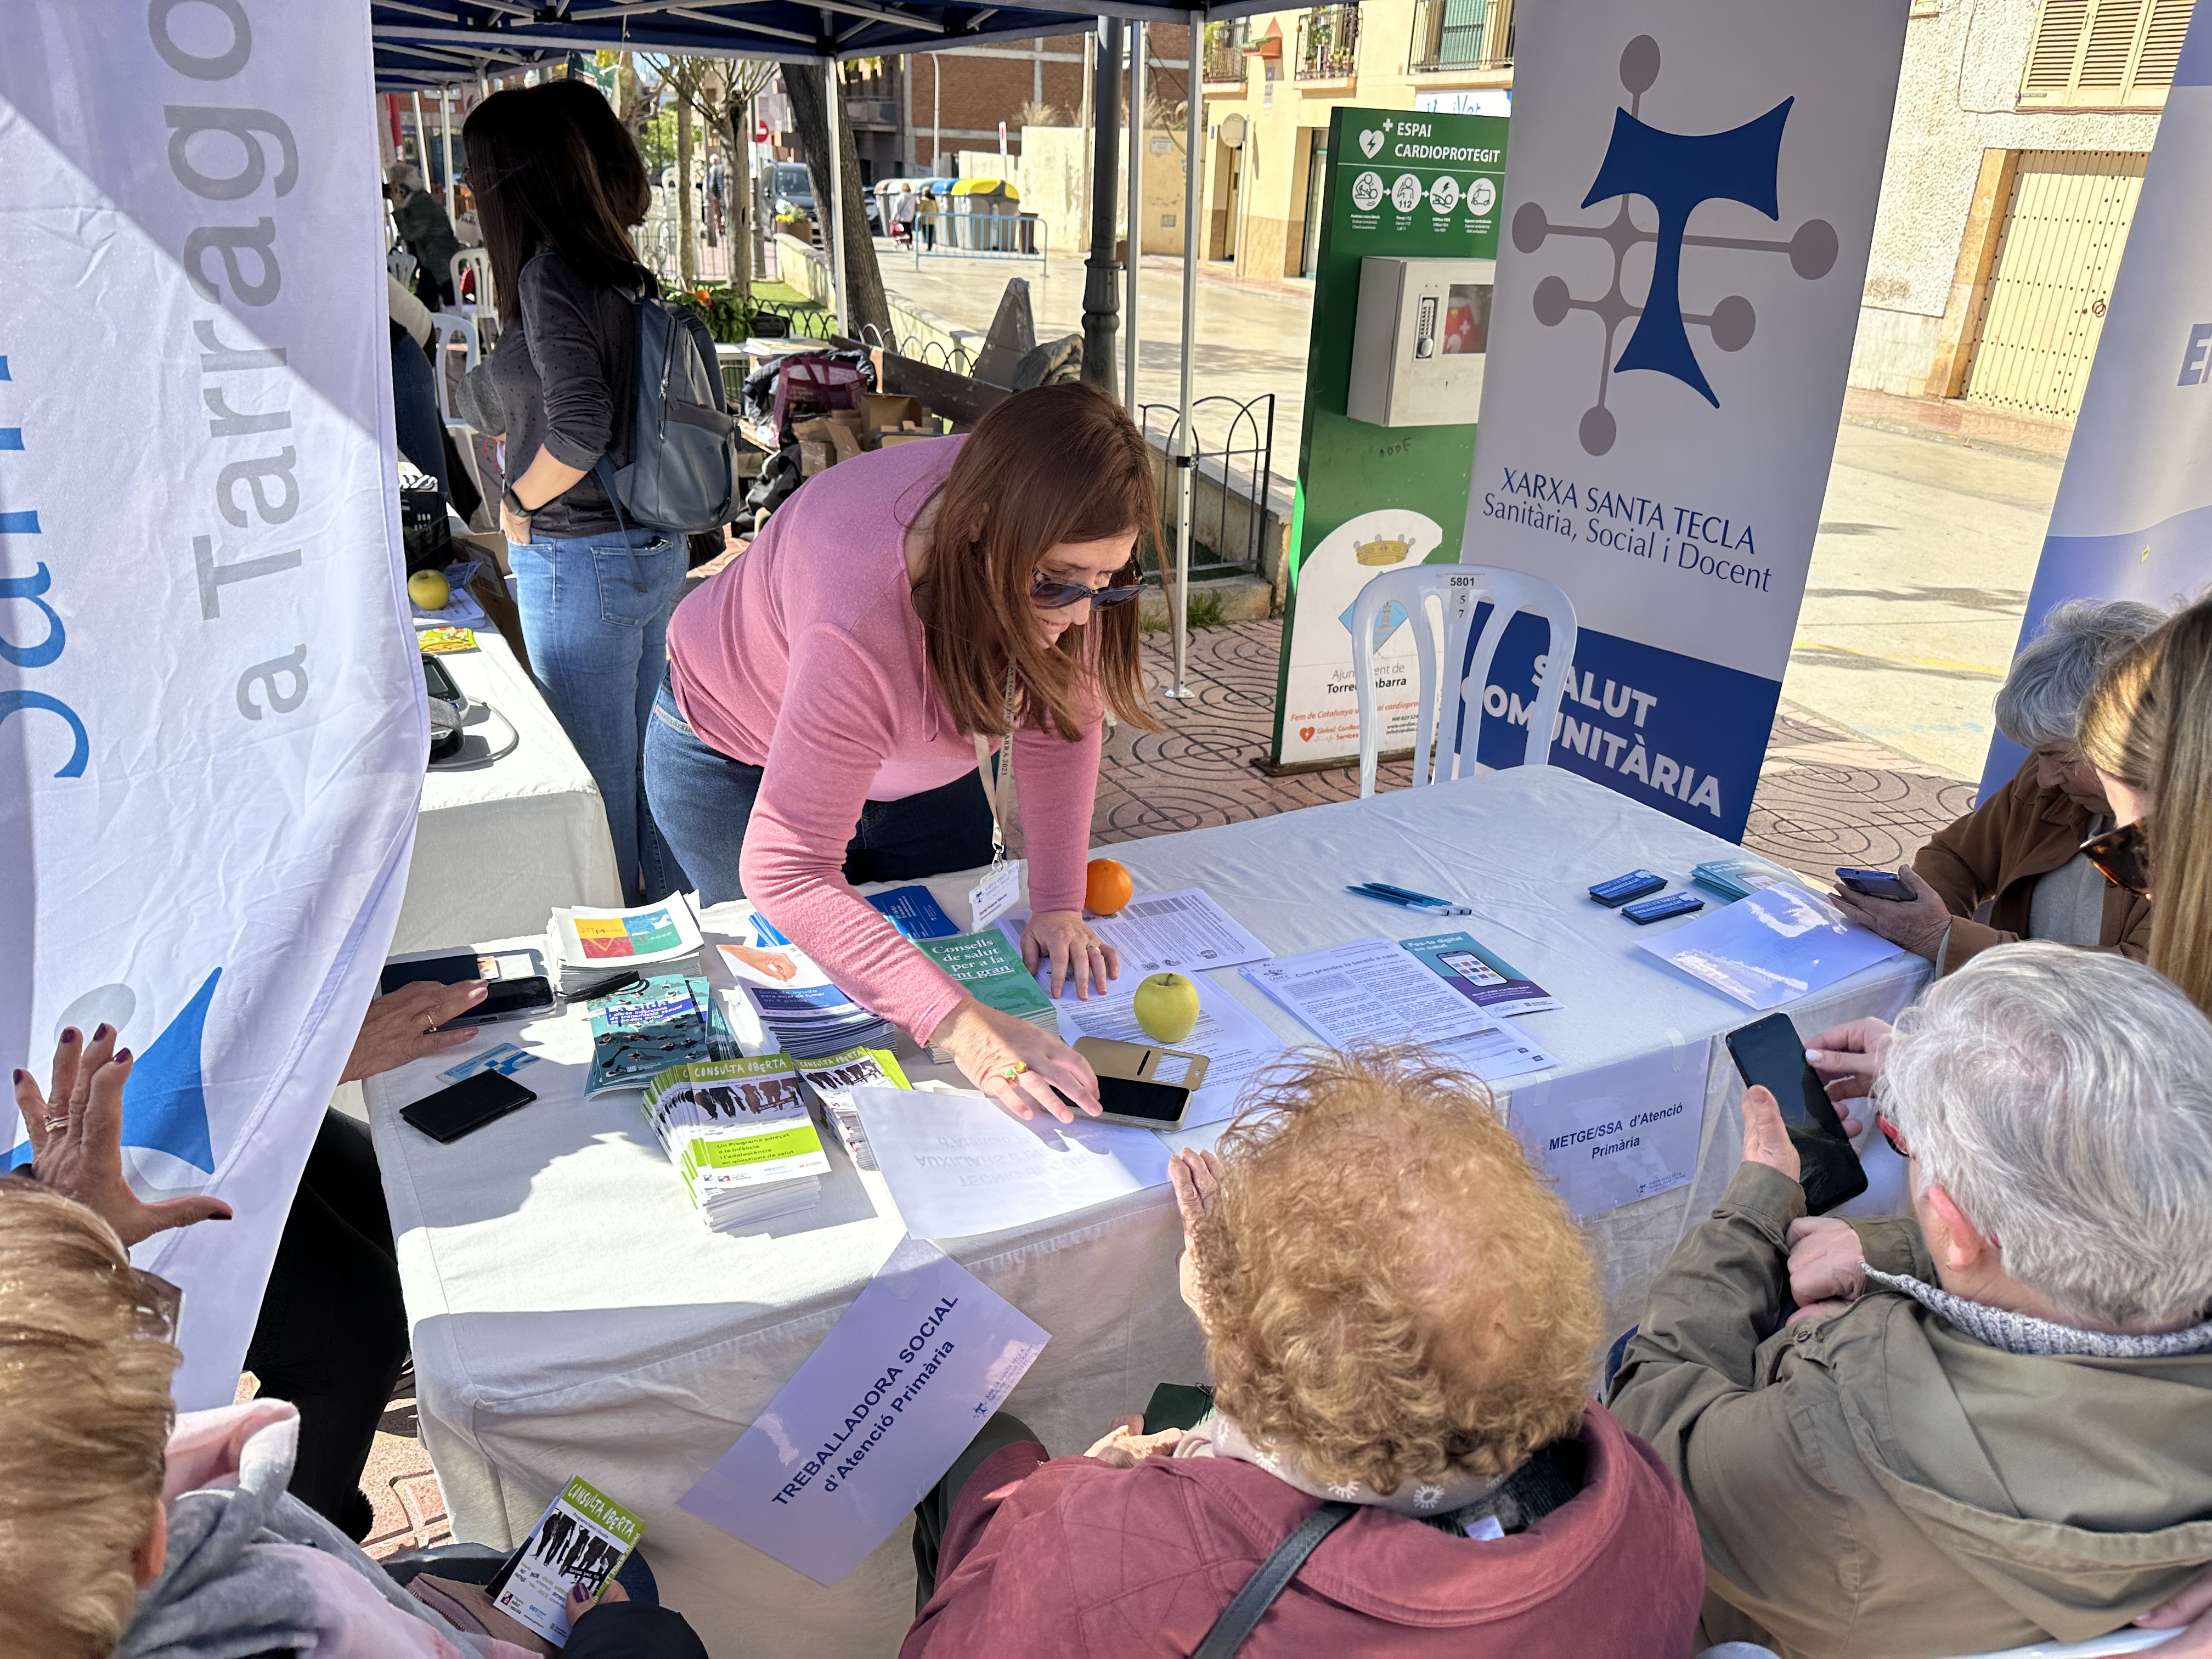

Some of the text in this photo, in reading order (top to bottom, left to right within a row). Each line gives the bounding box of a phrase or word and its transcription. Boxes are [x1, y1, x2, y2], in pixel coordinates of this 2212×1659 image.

[1397, 122, 1432, 137] ESPAI
[1395, 143, 1500, 163] CARDIOPROTEGIT
[1398, 200, 1412, 209] 112
[2177, 323, 2212, 387] E
[1501, 467, 1755, 554] XARXA SANTA TECLA
[1483, 492, 1771, 592] Sanitària, Social i Docent
[1450, 577, 1475, 586] 5801
[1459, 596, 1466, 605] 5
[1458, 610, 1464, 618] 7
[1331, 663, 1405, 682] Ajunent de
[236, 643, 309, 721] a
[1327, 678, 1407, 694] Torrebarra
[1531, 654, 1657, 729] SALUT
[1317, 708, 1354, 718] Catalunya
[1317, 726, 1336, 734] Global
[932, 939, 995, 954] Consells
[943, 947, 1000, 962] de salut
[950, 962, 975, 972] per
[950, 966, 1011, 979] ent gran
[1314, 964, 1344, 974] prendre
[661, 1005, 682, 1014] sexual
[799, 1049, 864, 1068] CONSULTA OBERTA
[695, 1063, 743, 1077] CONSULTA
[748, 1058, 787, 1073] OBERTA
[1549, 1102, 1683, 1150] METGE/SSA d'Atenció
[729, 1138, 763, 1147] Programa
[764, 1133, 790, 1141] adreçat
[1592, 1136, 1640, 1159] Primària
[732, 1155, 766, 1165] qüestions
[771, 1296, 958, 1506] TREBALLADORA SOCIAL
[823, 1340, 955, 1493] d'Atenció Primària
[567, 1483, 636, 1538] CONSULTA OBERTA
[573, 1512, 588, 1525] Programa
[588, 1522, 597, 1531] Salut
[597, 1530, 608, 1539] Escola
[605, 1576, 612, 1584] ET
[612, 1554, 626, 1575] PODEM
